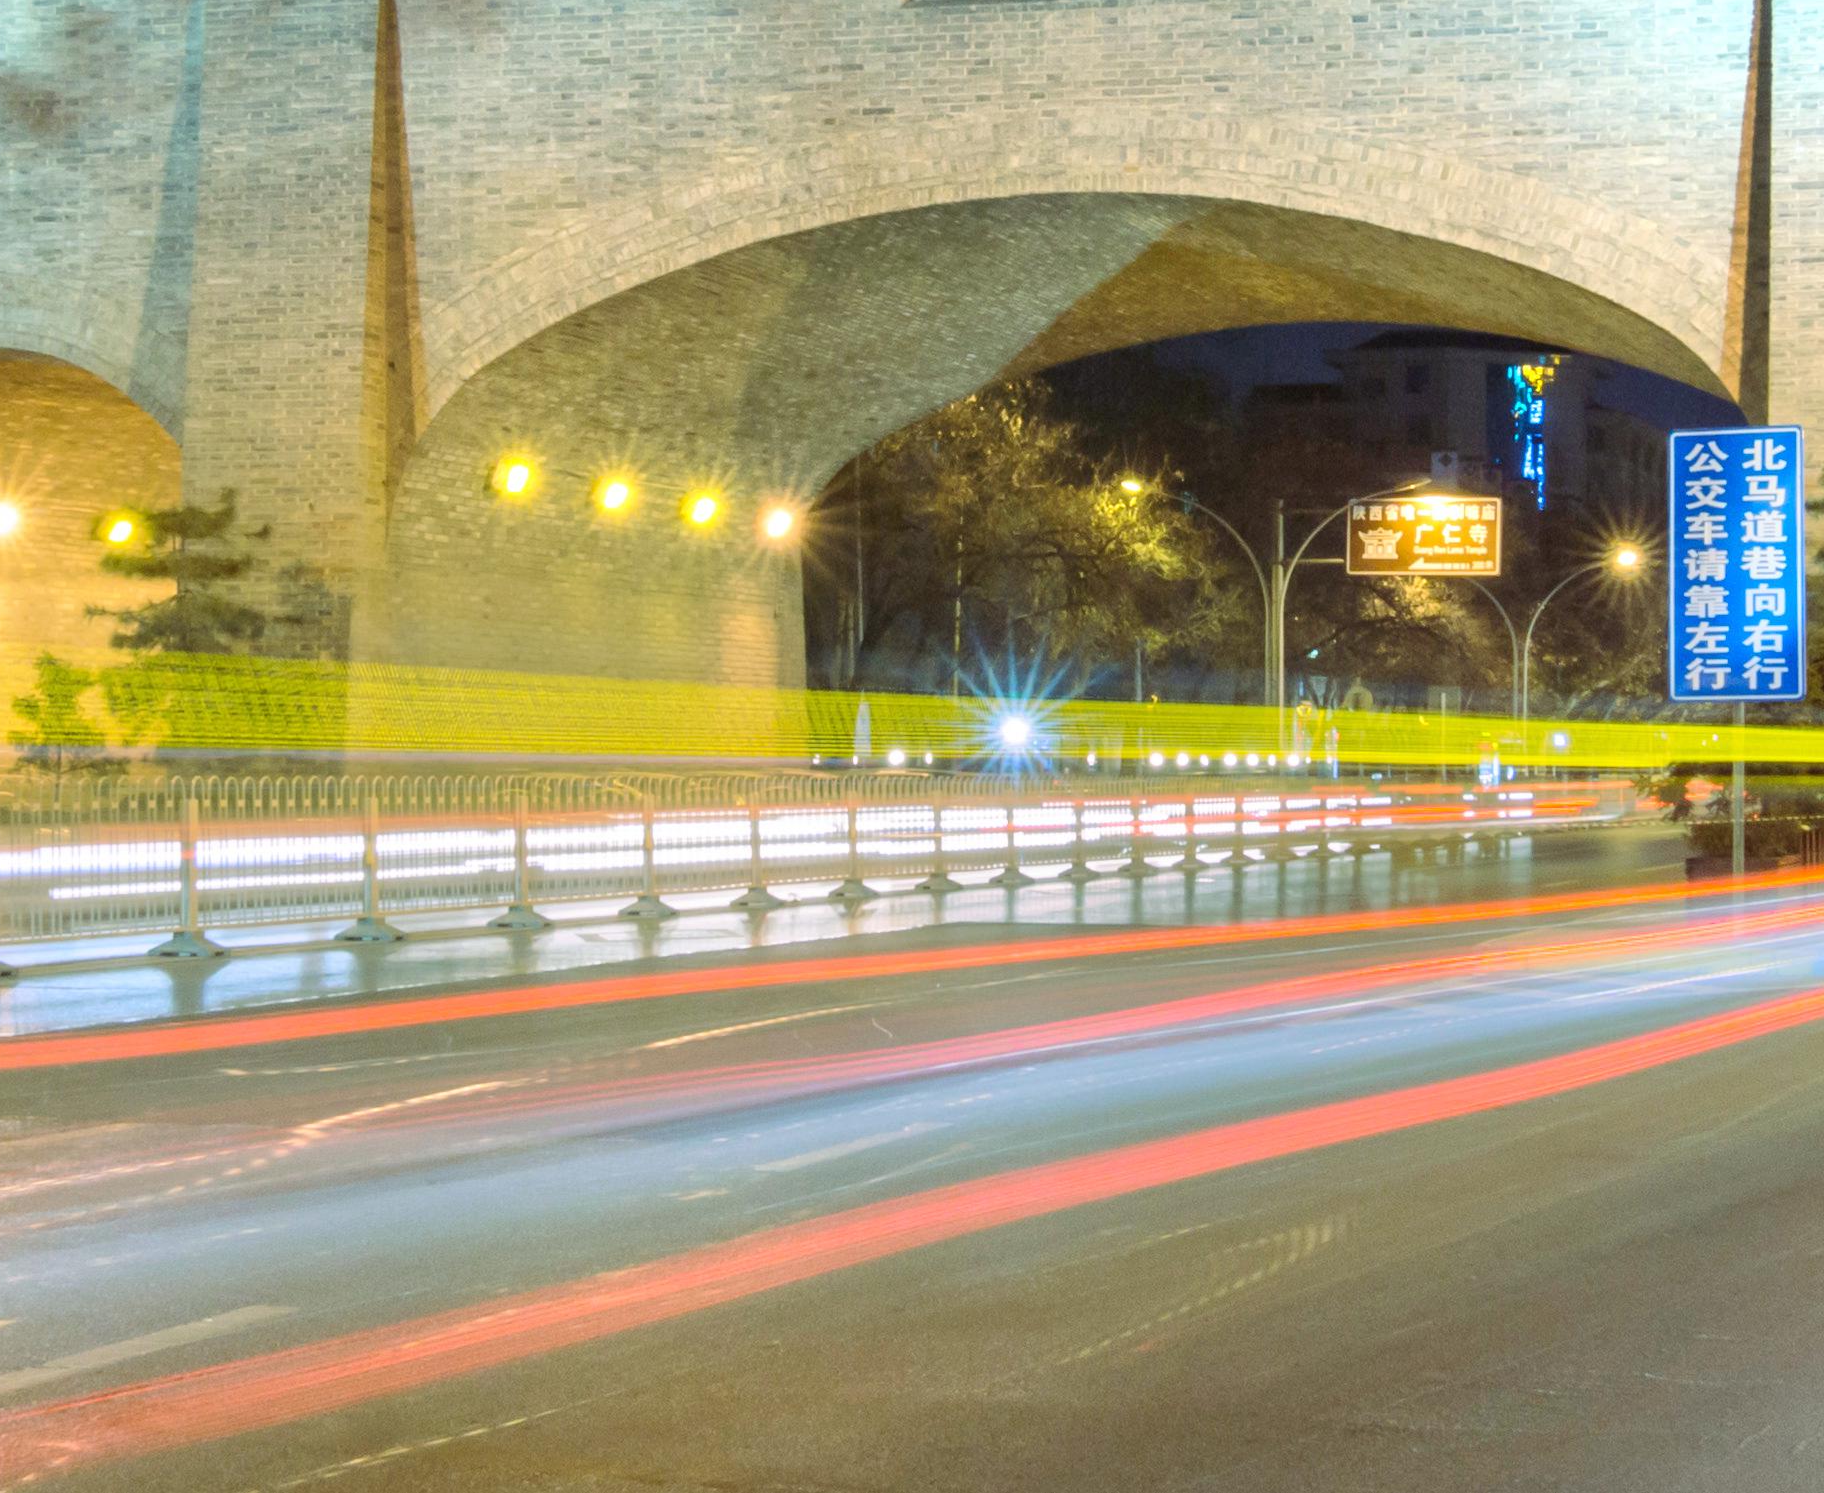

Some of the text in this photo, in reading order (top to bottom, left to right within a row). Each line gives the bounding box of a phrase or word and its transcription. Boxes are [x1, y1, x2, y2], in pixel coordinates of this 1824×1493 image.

[1414, 523, 1488, 544] 广仁寺
[1683, 440, 1732, 691] 公交车请靠左行
[1740, 438, 1789, 690] 北马道巷向右行
